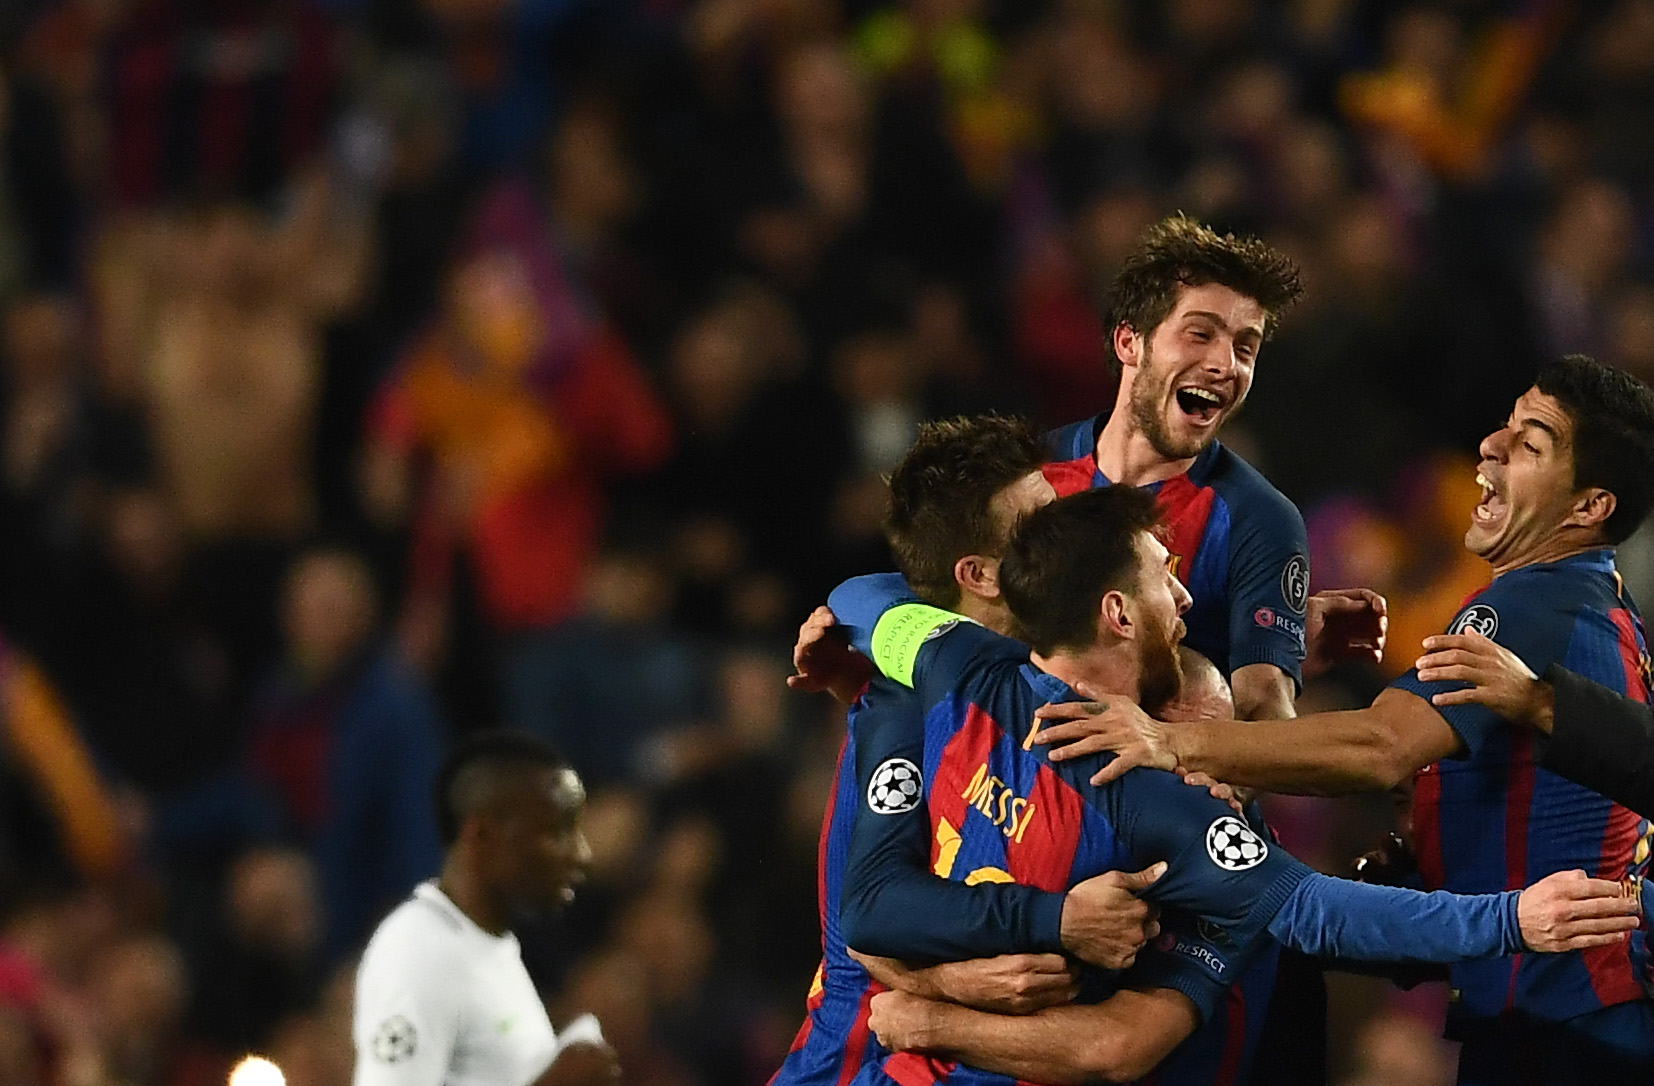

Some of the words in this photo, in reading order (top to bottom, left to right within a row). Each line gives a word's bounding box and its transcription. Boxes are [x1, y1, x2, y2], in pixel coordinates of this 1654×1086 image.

[1294, 583, 1303, 598] 5
[883, 612, 913, 660] RESPECT
[961, 763, 1036, 843] MESSI
[1175, 942, 1226, 974] RESPECT
